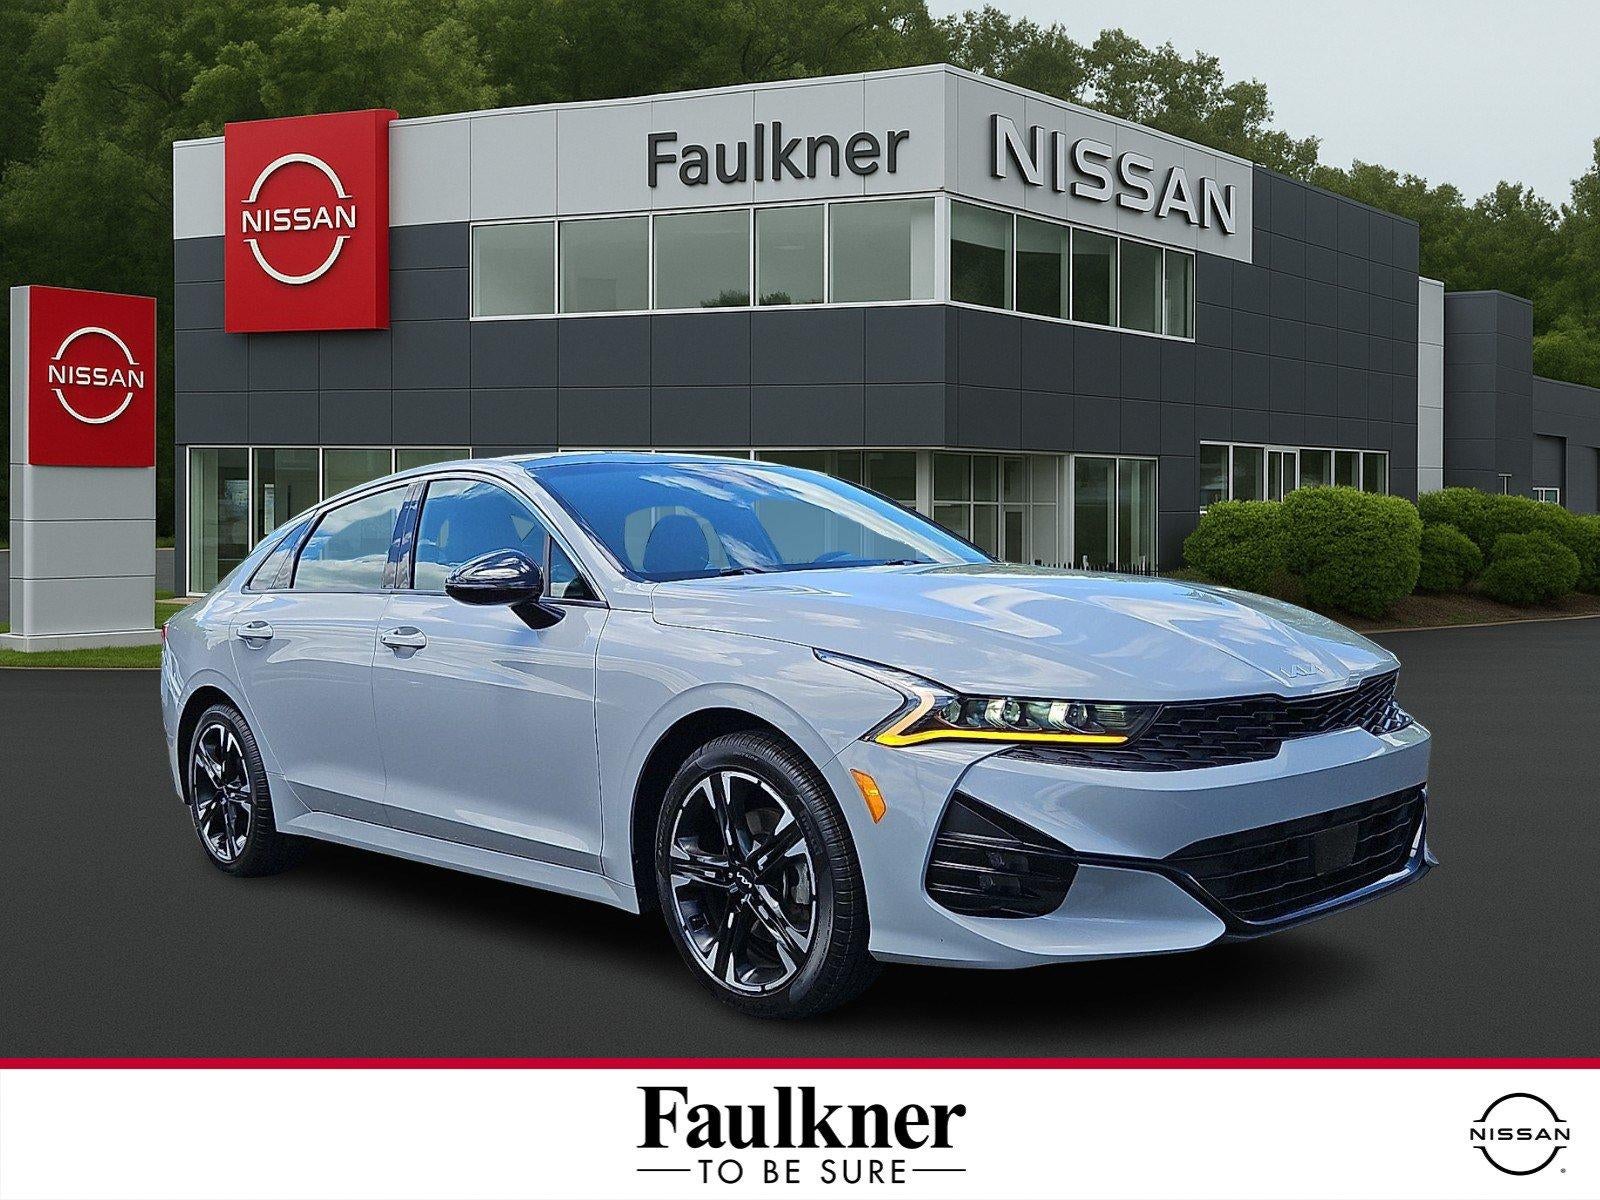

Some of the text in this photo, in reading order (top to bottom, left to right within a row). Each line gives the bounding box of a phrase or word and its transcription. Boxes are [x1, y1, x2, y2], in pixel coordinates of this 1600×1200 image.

[647, 121, 910, 188] Faulkner
[990, 113, 1236, 235] NISSAN
[241, 204, 356, 233] NISSAN
[48, 364, 144, 388] NISSAN
